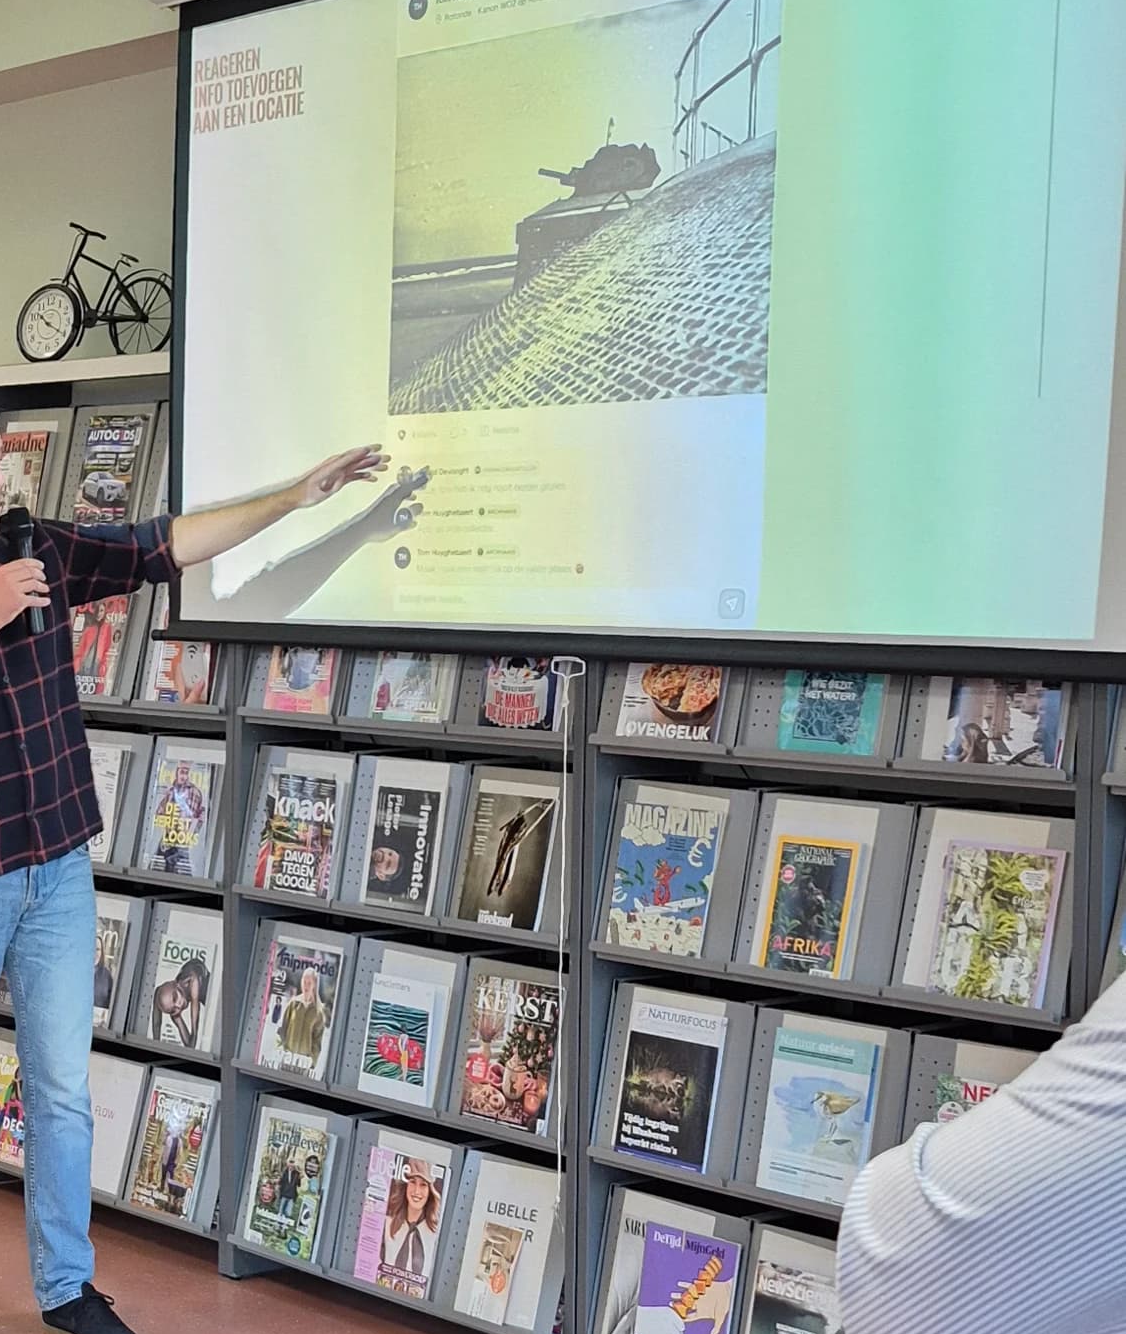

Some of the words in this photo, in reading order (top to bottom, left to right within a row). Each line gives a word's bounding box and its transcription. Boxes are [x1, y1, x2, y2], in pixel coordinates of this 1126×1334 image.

[194, 47, 262, 84] REAGEREN
[194, 82, 223, 109] INFO
[226, 65, 304, 103] TOEVOEGEN
[194, 108, 220, 135] AAN
[223, 103, 246, 130] EEN
[250, 91, 305, 125] LOCATIE
[274, 789, 336, 825] knack
[624, 802, 720, 840] MAGAZINE
[162, 828, 200, 846] LOOKS
[284, 849, 315, 866] DAVID
[409, 804, 432, 900] Innovatie
[799, 845, 834, 859] NATIONAL
[282, 861, 315, 879] TEGEN
[275, 872, 318, 893] GOOGLE
[772, 934, 832, 957] AFRIKA
[475, 986, 559, 1024] KERST
[93, 1104, 116, 1121] FLOW
[486, 1200, 539, 1224] LIBELLE
